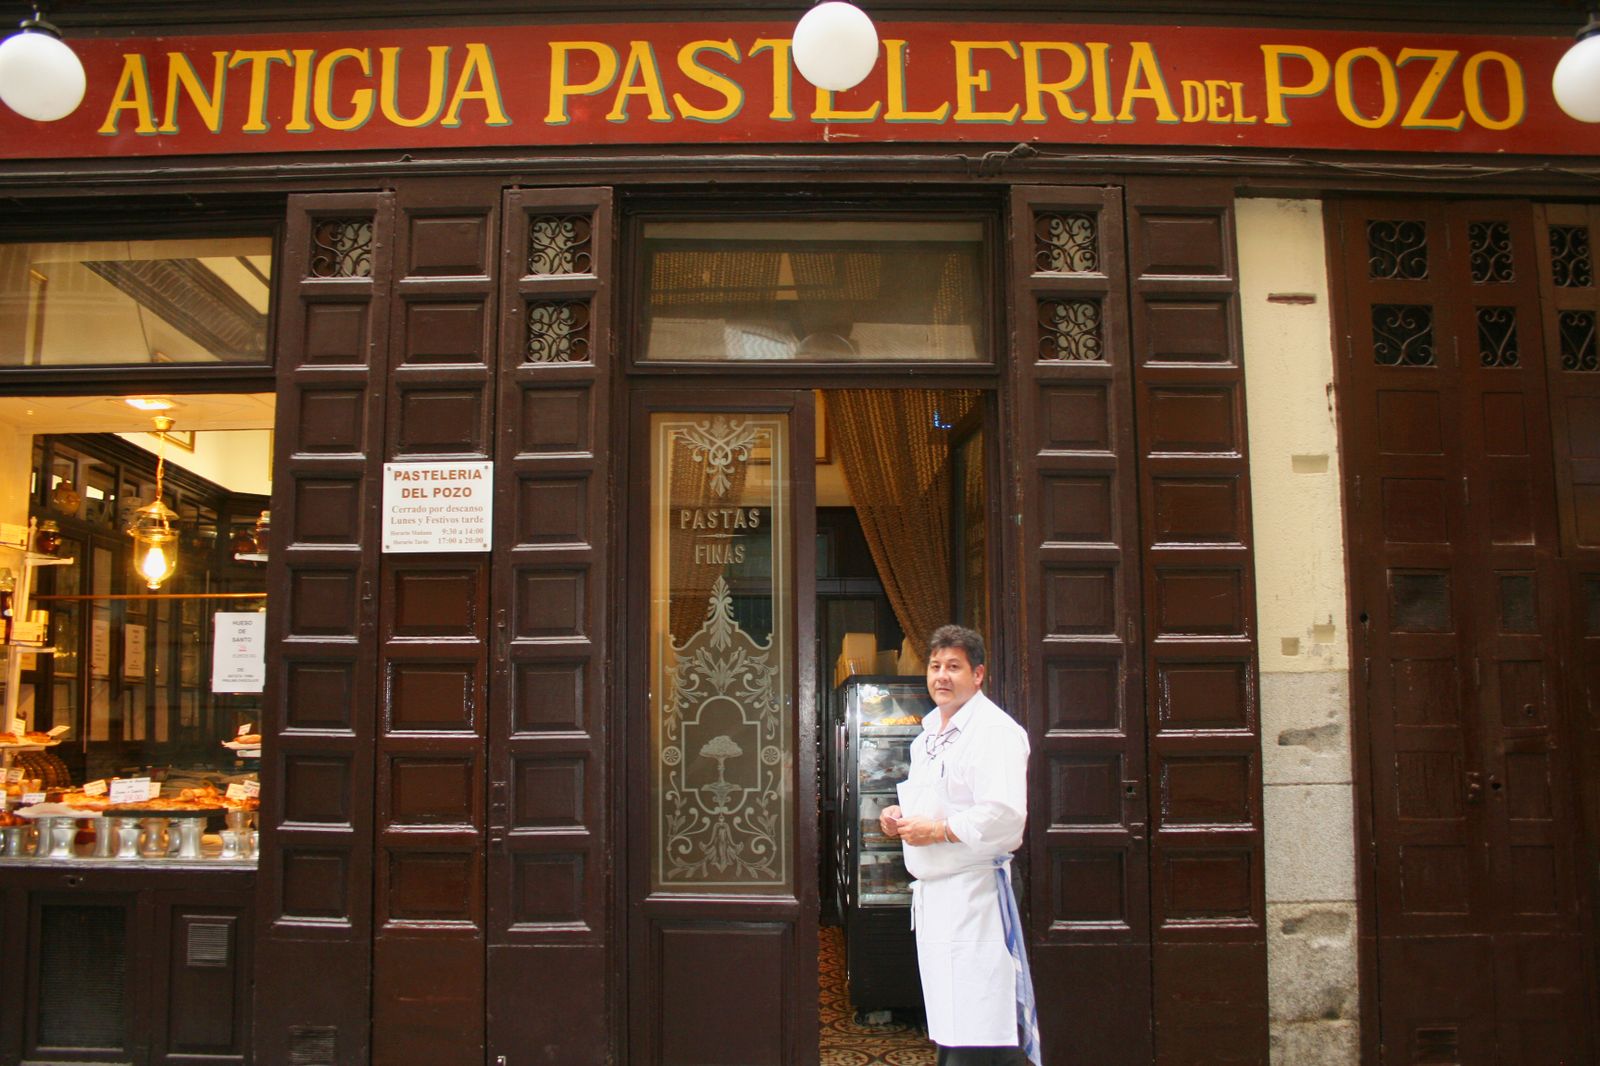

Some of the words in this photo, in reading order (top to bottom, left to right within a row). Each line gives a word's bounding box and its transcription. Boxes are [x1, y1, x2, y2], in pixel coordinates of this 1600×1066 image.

[98, 42, 512, 136] ANTIGUA
[1181, 79, 1257, 124] DEL
[1260, 44, 1526, 132] POZO
[394, 469, 482, 481] PASTELERIA
[401, 488, 428, 499] DEL
[433, 487, 472, 498] POZO
[391, 505, 427, 514] Cerrado
[429, 506, 443, 515] por
[446, 504, 483, 513] descanso
[390, 516, 416, 525] Lunes
[418, 518, 424, 526] y
[425, 515, 459, 524] Festivos
[461, 515, 484, 524] tarde
[680, 508, 761, 529] PASTAS
[694, 543, 746, 565] FINAS
